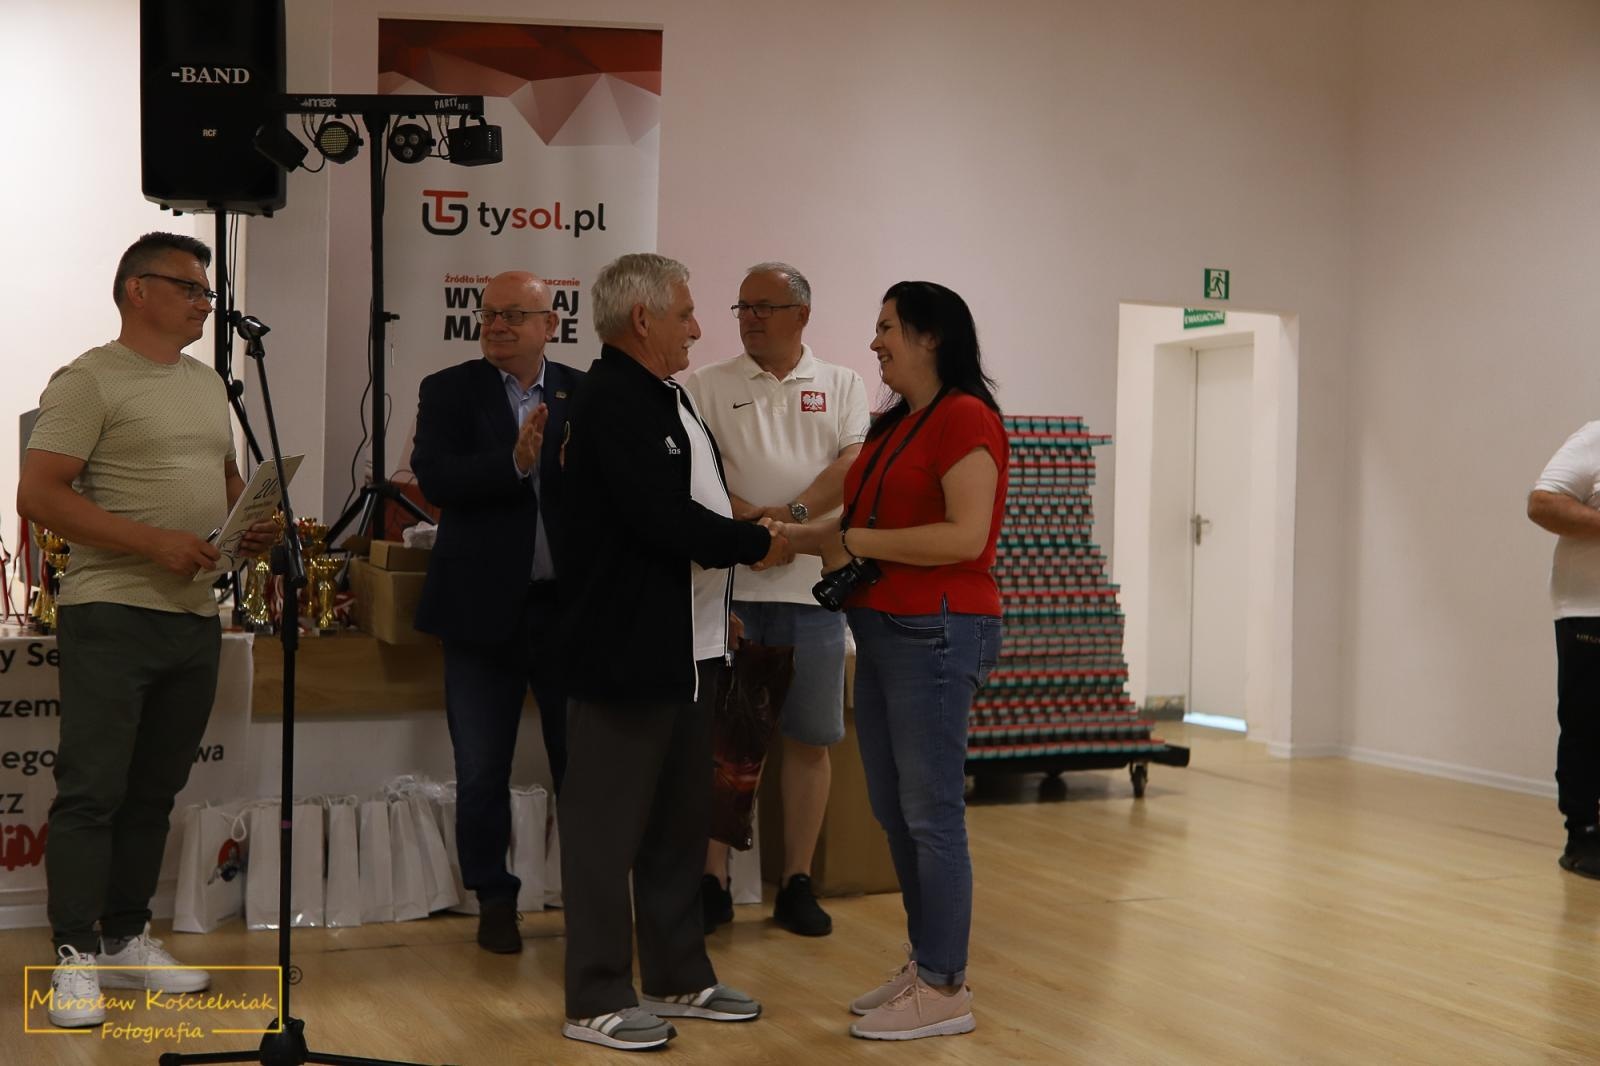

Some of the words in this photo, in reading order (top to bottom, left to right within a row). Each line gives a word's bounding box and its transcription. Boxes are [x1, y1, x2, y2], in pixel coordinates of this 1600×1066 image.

[477, 202, 606, 238] tysol.pl
[27, 642, 60, 667] Se
[1, 750, 57, 777] ego
